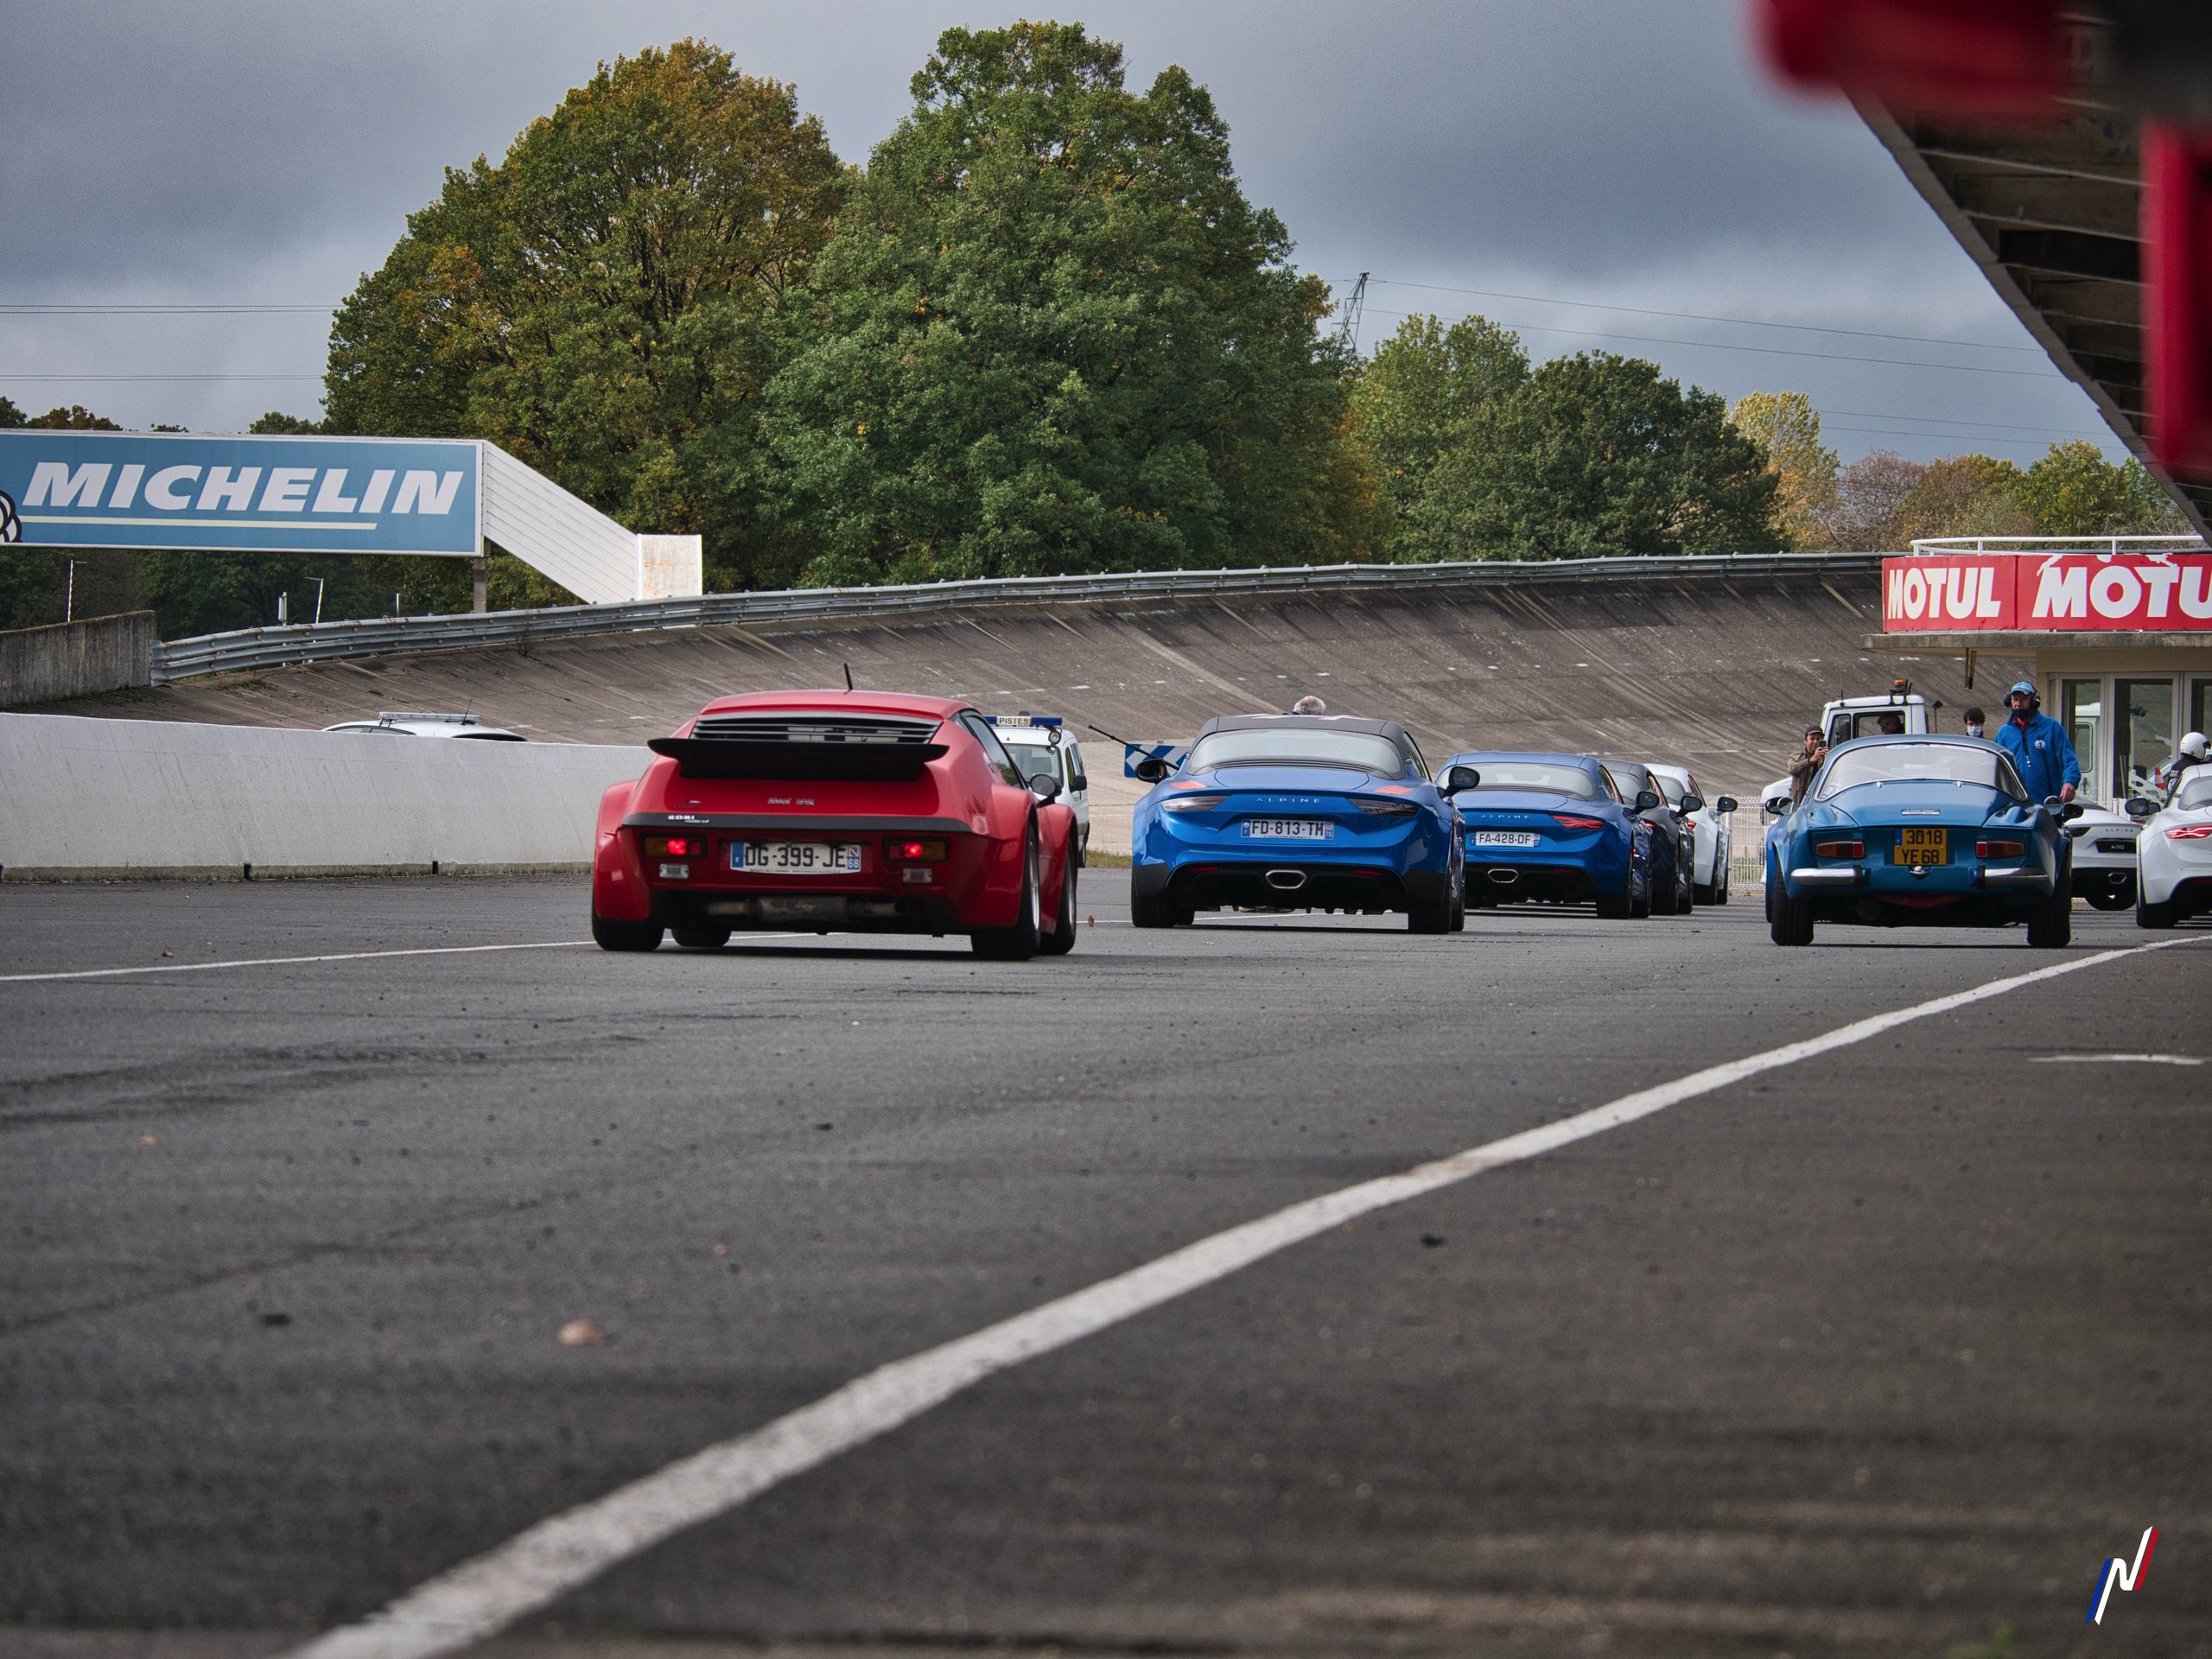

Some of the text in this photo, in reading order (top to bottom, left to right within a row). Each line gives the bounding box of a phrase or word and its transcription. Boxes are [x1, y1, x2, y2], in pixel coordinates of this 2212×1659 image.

[22, 461, 463, 515] MICHELIN
[1888, 567, 2001, 620] MOTUL
[1478, 833, 1531, 844] FA-428-DF
[1906, 830, 1942, 844] 3018
[745, 845, 846, 868] DG-399-JE
[849, 858, 859, 868] 68
